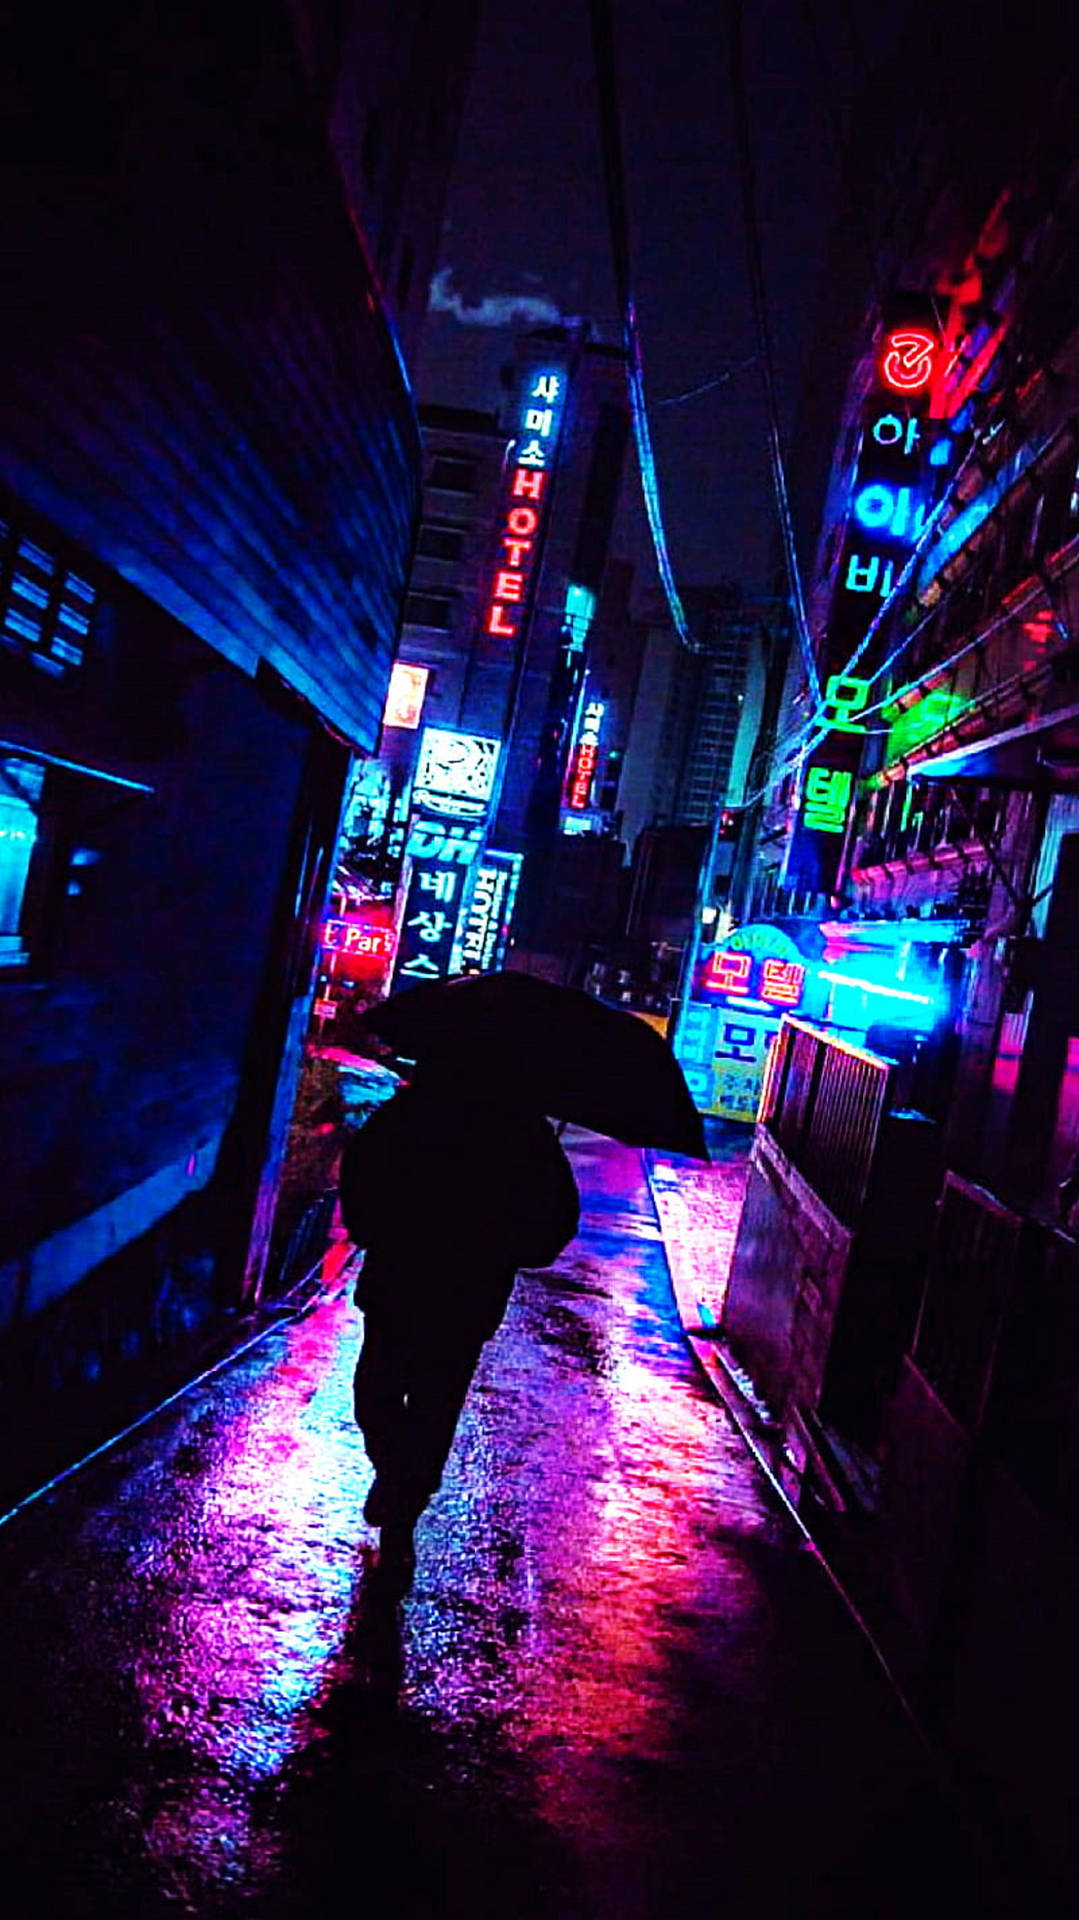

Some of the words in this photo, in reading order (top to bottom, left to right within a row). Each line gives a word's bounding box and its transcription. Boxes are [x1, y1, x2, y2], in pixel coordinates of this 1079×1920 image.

[519, 375, 560, 466] 샤미소
[488, 468, 545, 636] HOTEL
[571, 745, 595, 809] HOTEL
[803, 675, 871, 834] 모텔
[400, 869, 457, 979] 네상스
[706, 950, 806, 1005] 모텔
[714, 1023, 778, 1063] 모
